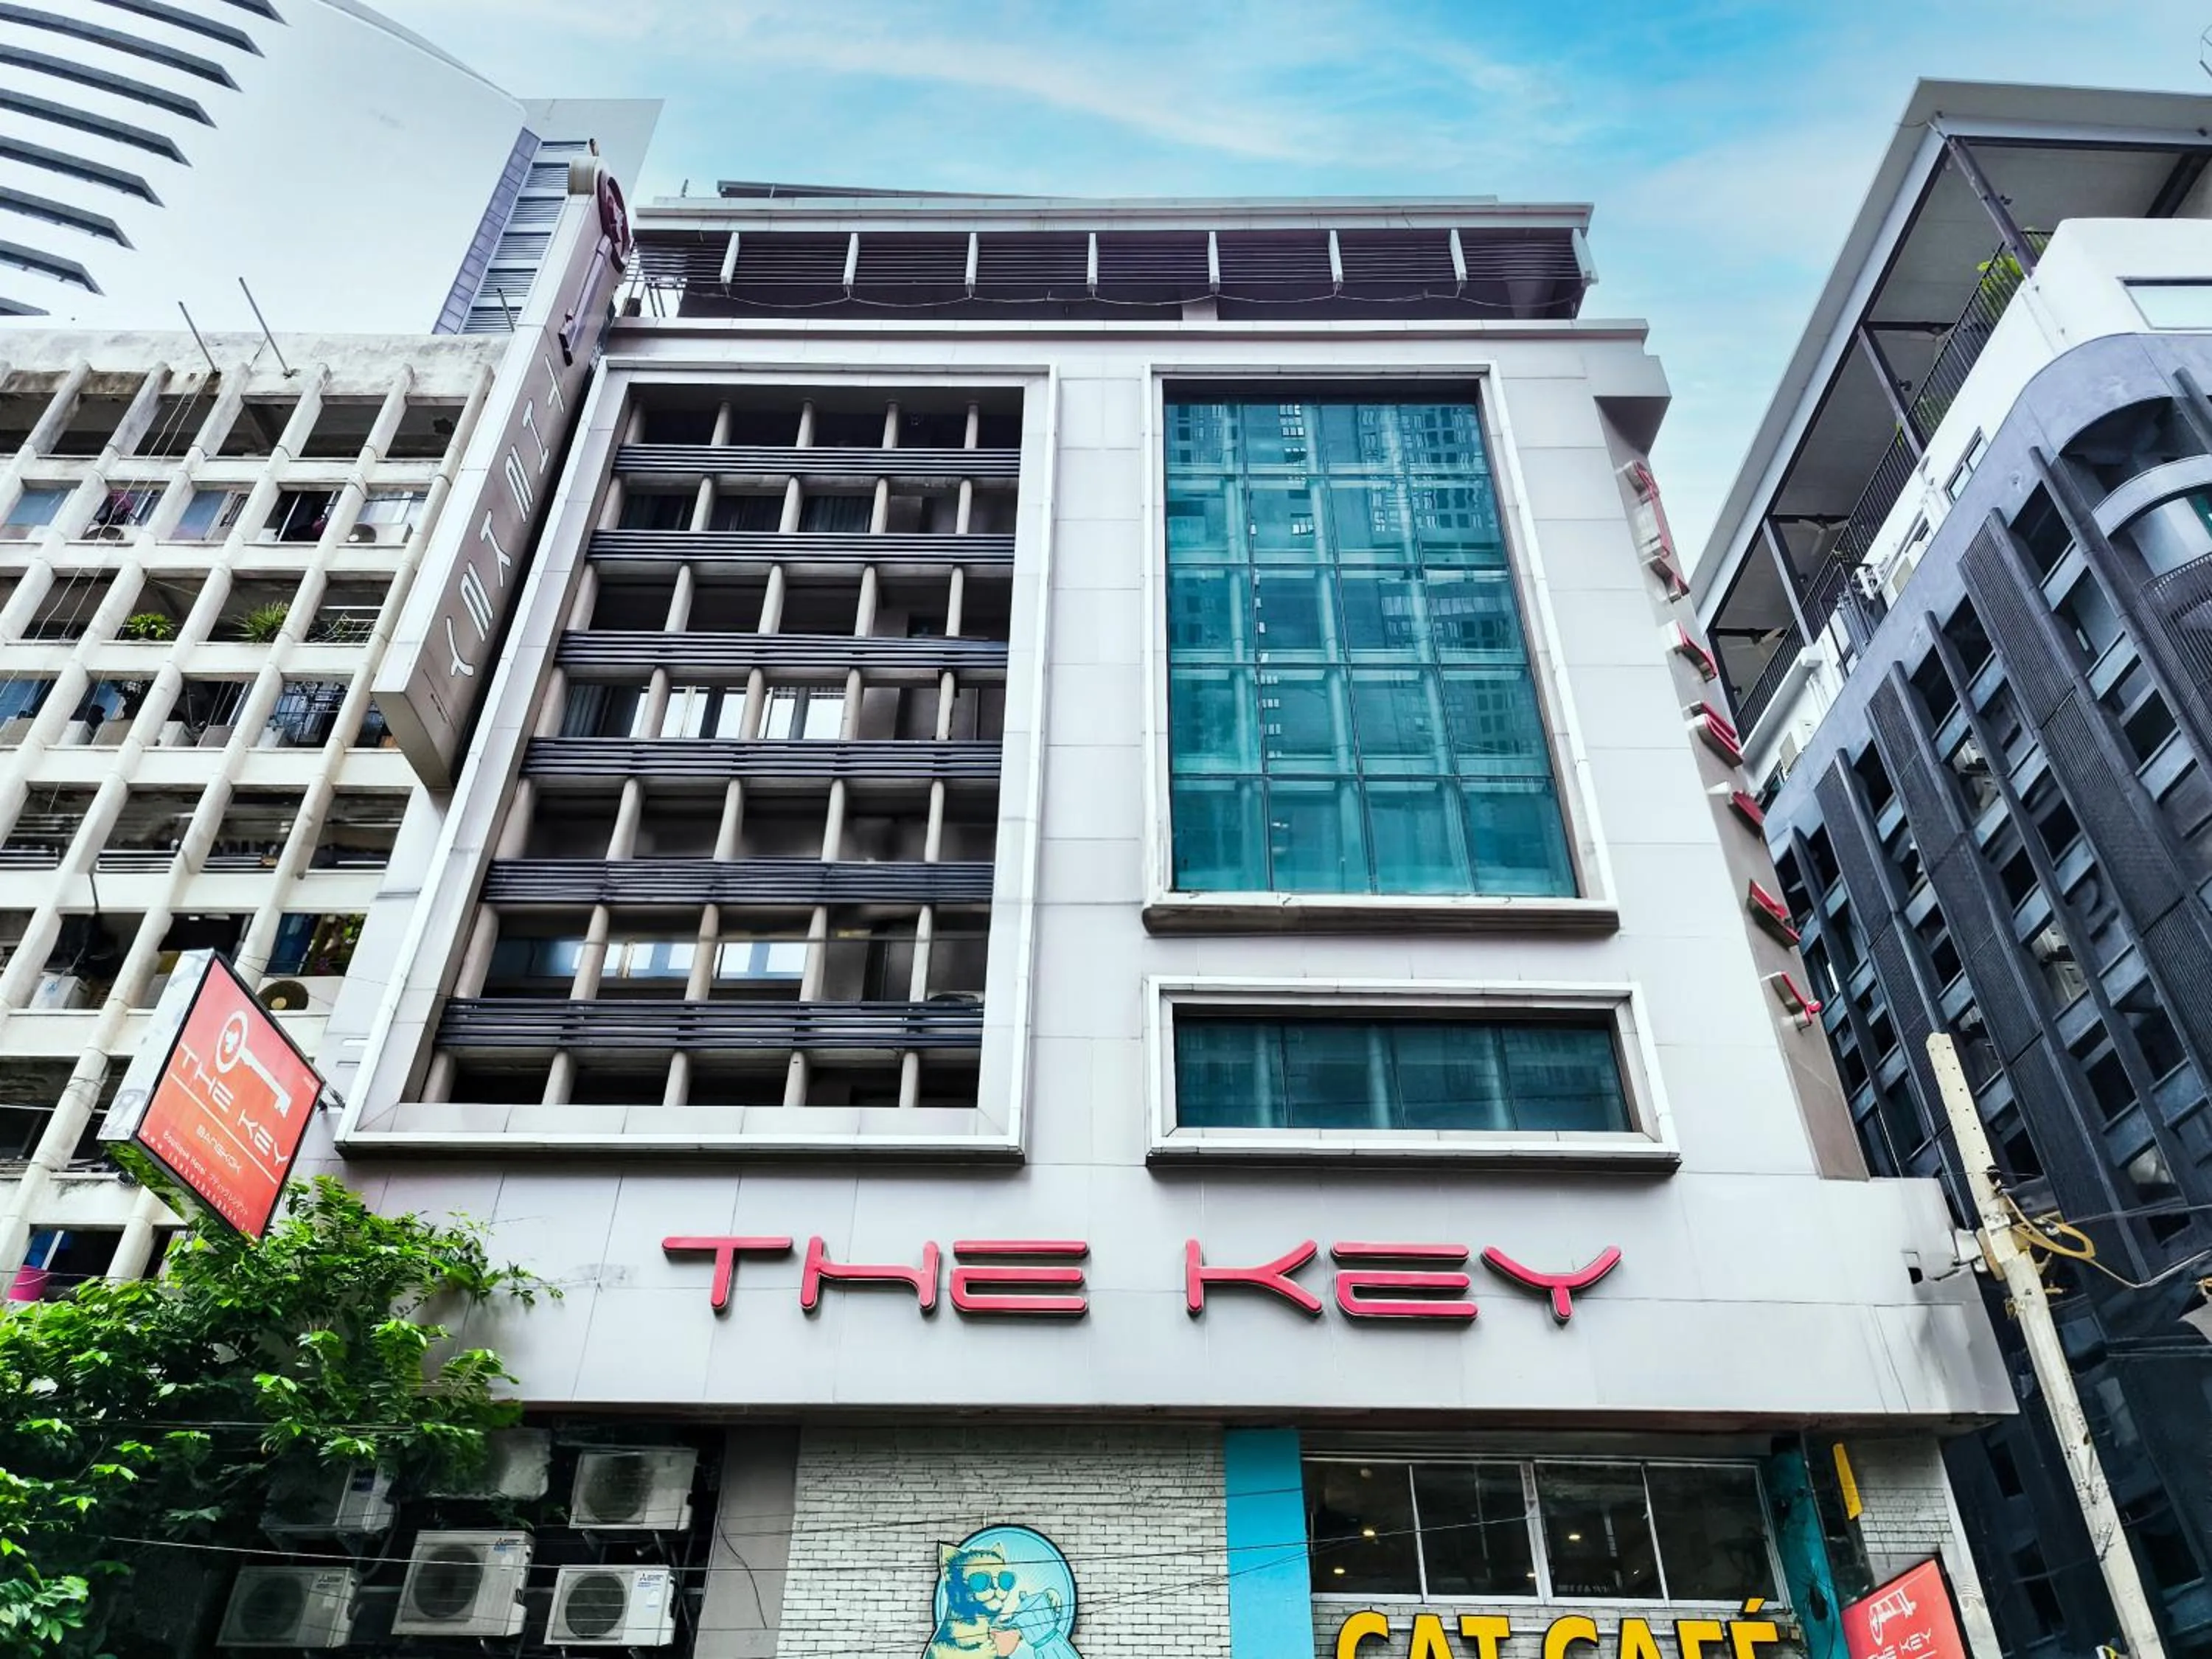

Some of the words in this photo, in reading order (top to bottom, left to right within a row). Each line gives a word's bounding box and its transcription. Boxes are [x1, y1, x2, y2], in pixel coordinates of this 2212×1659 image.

[445, 509, 512, 678] KEY
[181, 1041, 234, 1113] THE
[237, 1108, 289, 1166] KEY
[662, 1235, 1088, 1317] THE
[1186, 1238, 1622, 1321] KEY
[1899, 1627, 1931, 1656] KEY
